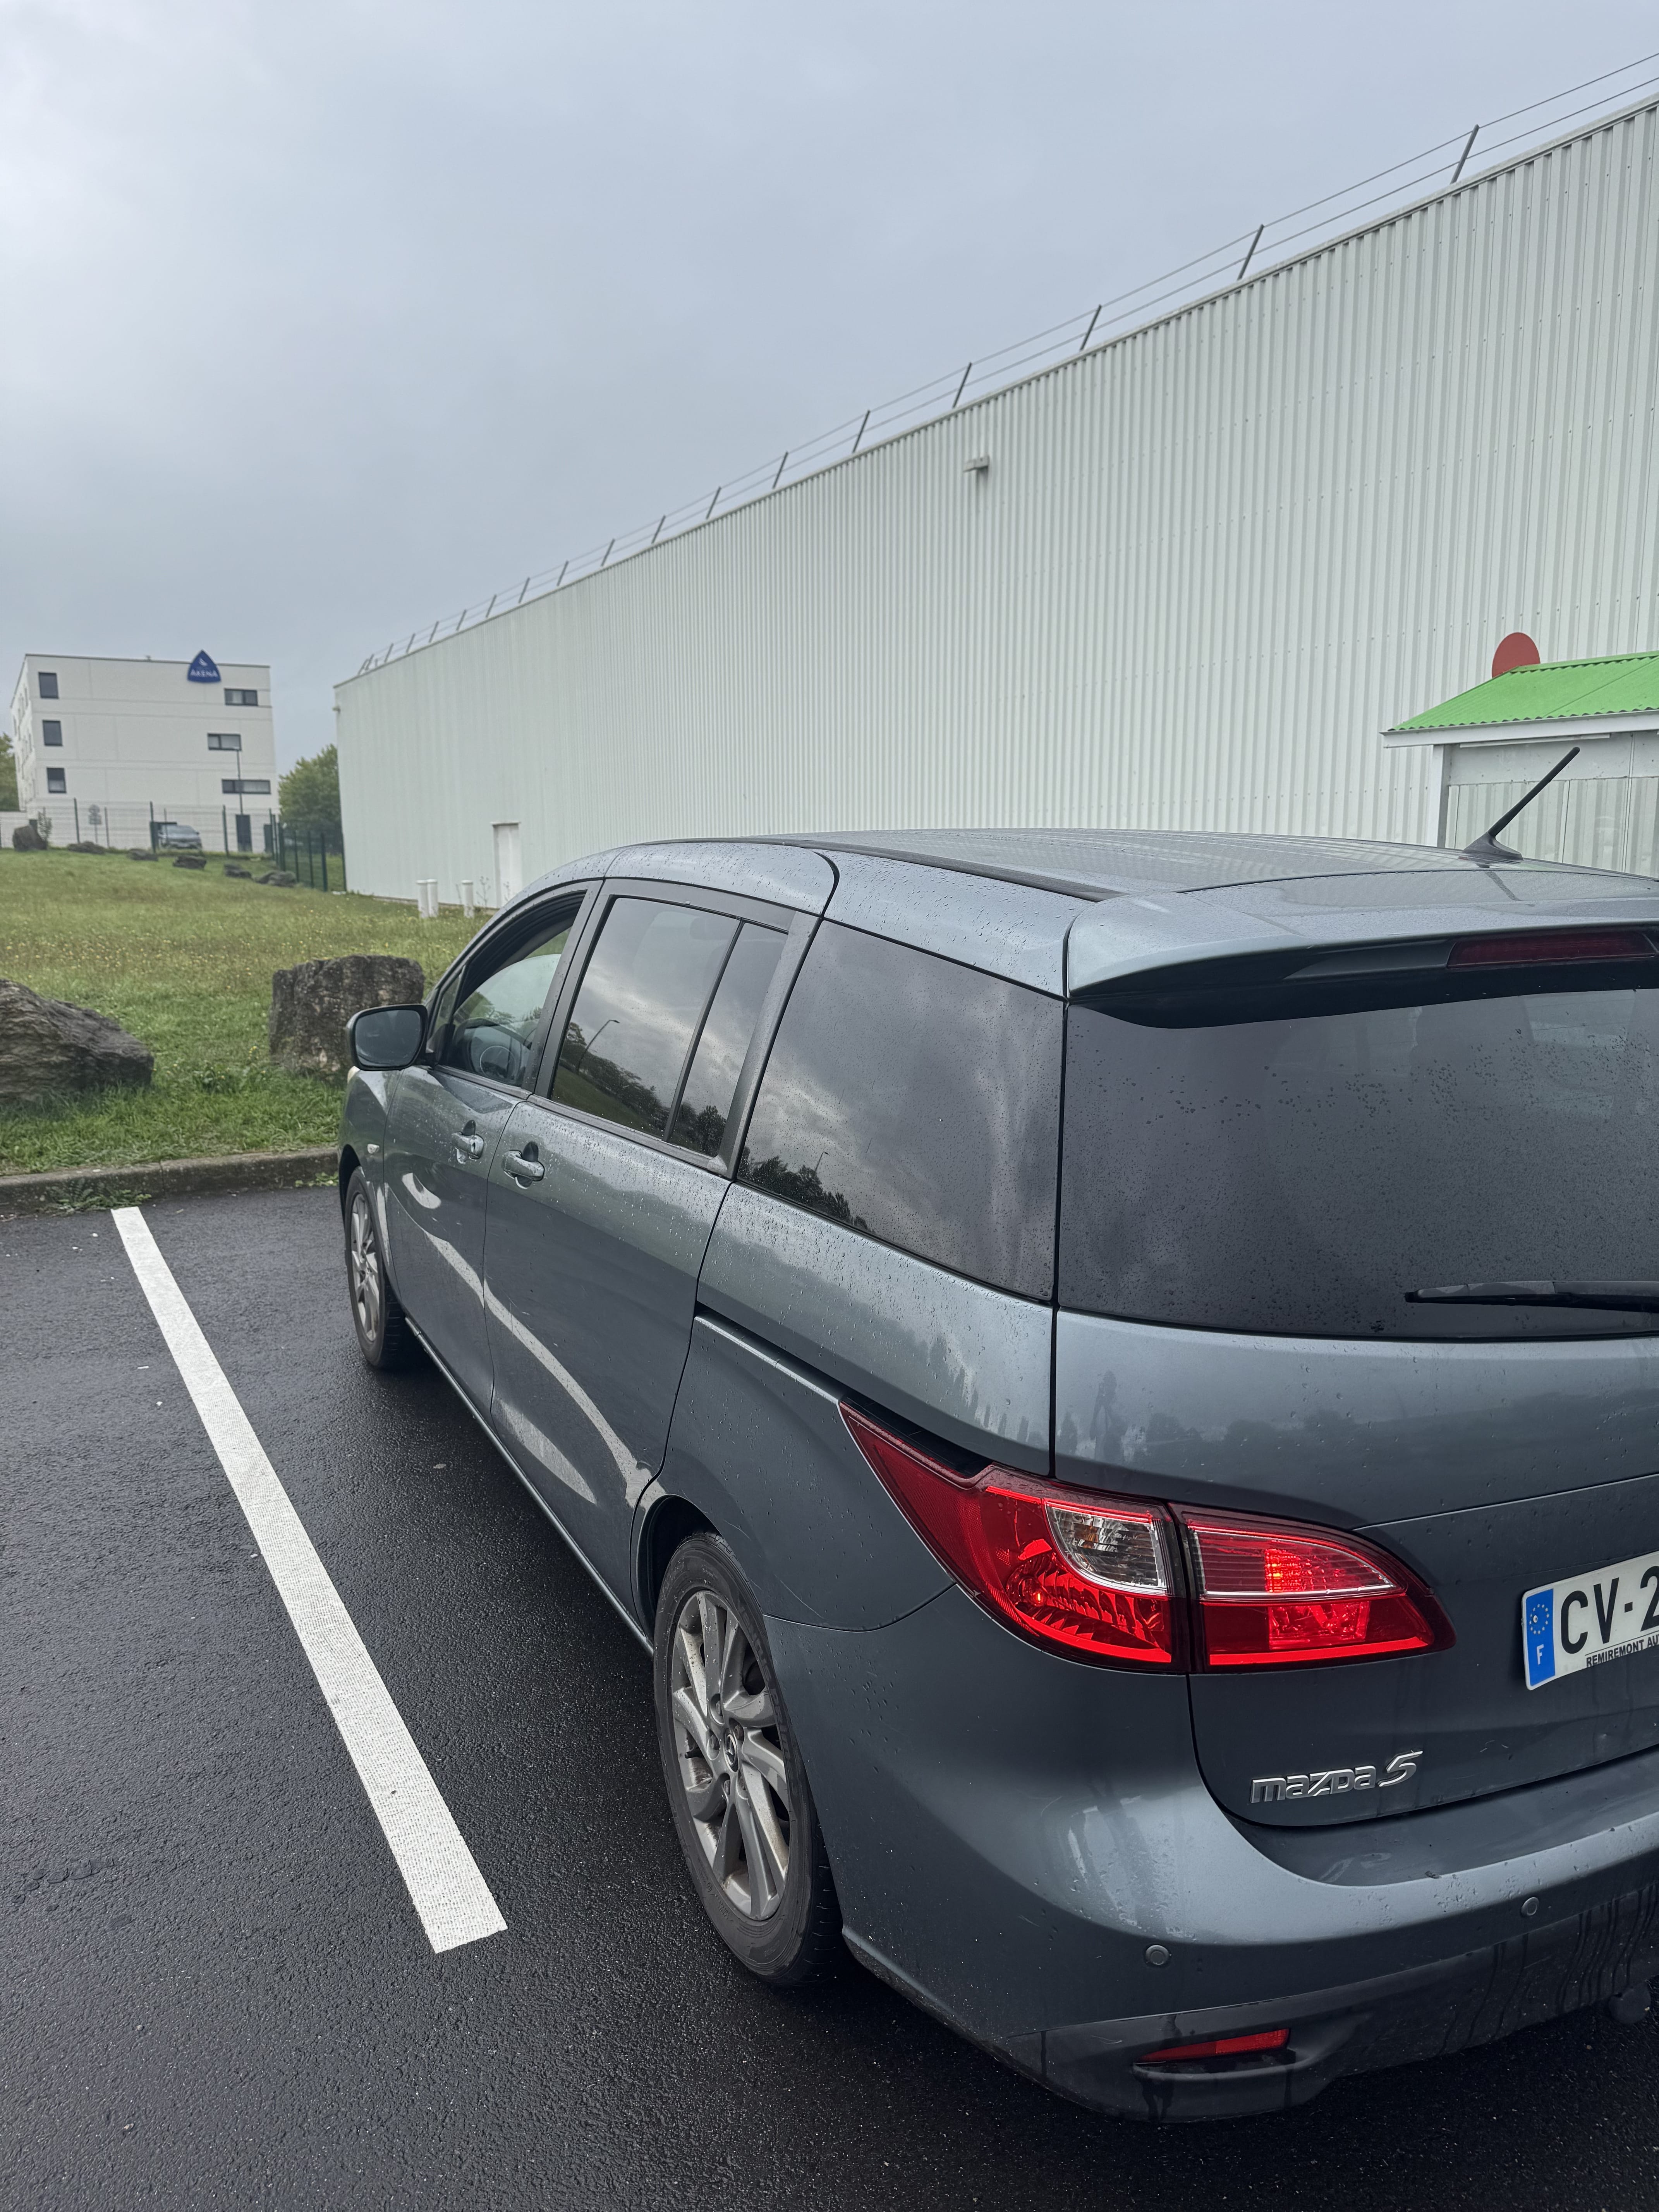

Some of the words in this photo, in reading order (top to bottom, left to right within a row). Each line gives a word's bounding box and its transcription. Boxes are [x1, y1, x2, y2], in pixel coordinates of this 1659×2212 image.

[1537, 1644, 1544, 1665] F
[1586, 1639, 1644, 1668] REMIREMONT
[1647, 1634, 1659, 1648] AU
